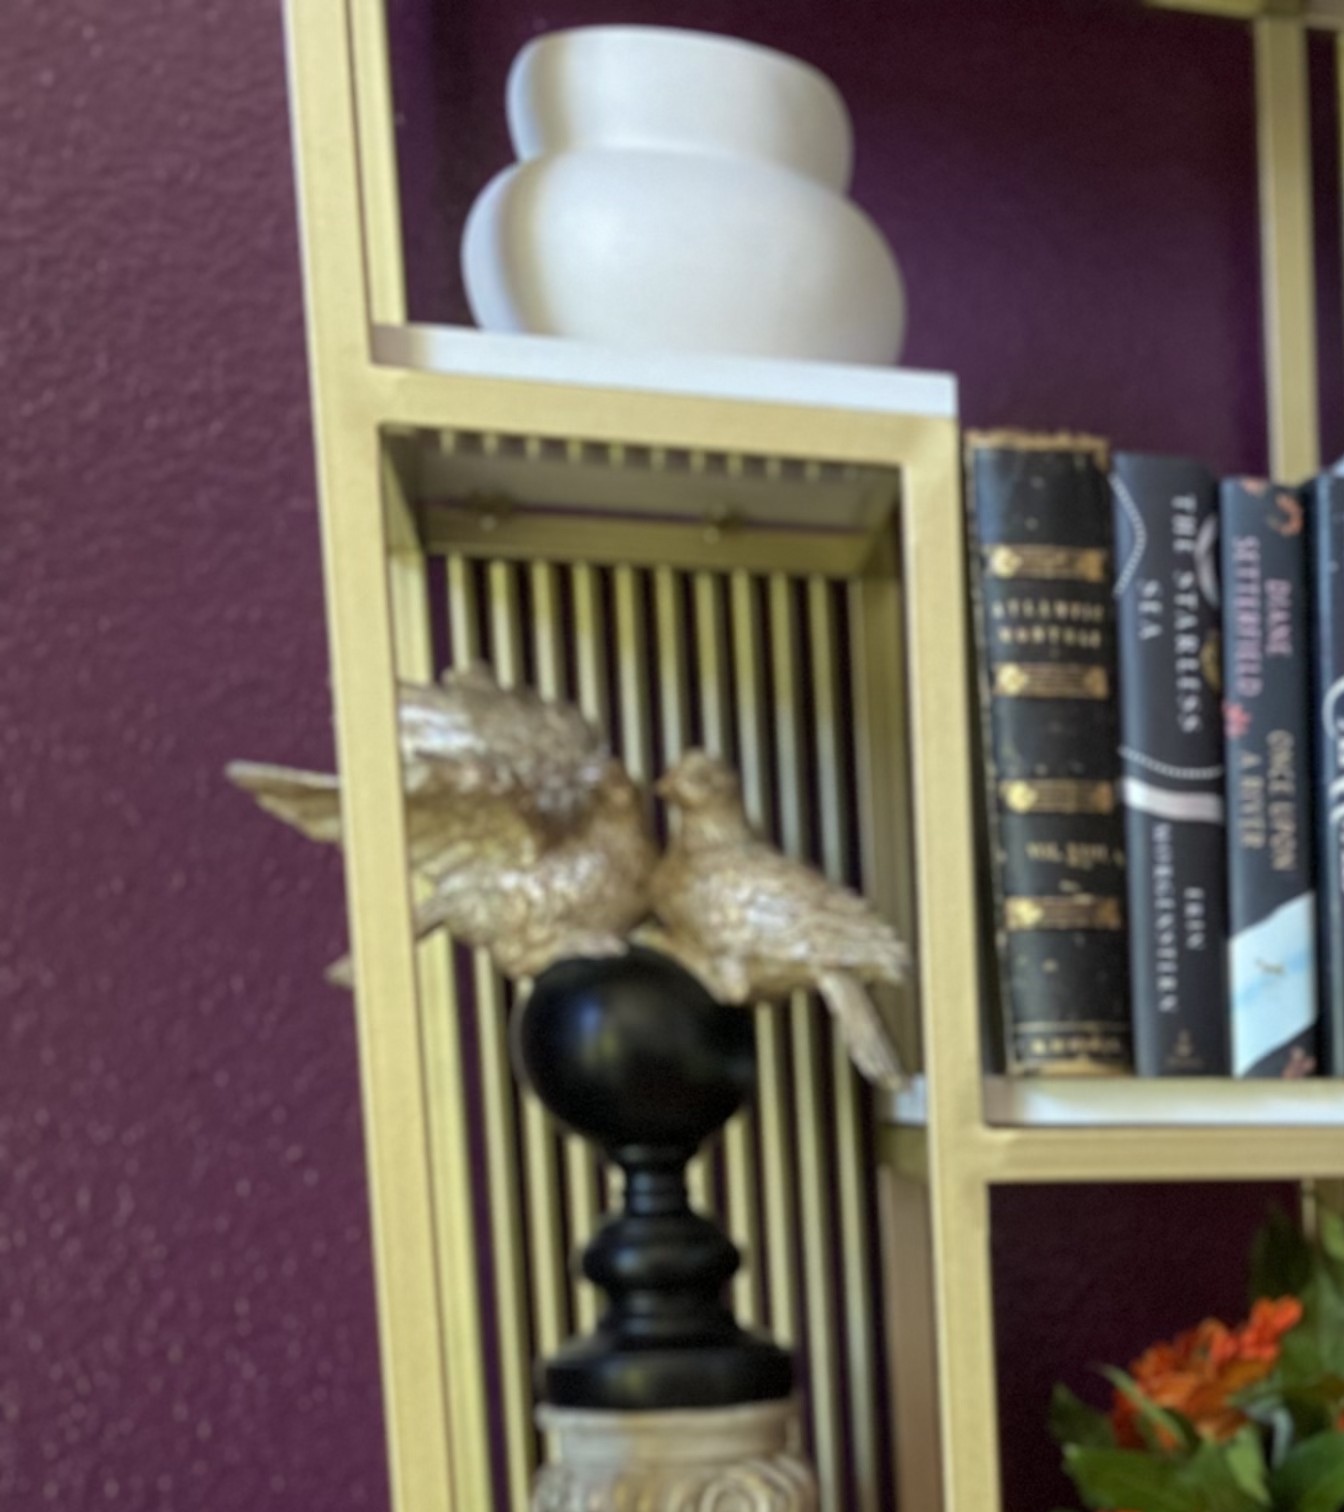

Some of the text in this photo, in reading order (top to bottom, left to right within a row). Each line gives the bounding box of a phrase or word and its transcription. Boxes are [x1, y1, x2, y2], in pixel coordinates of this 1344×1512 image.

[1137, 578, 1164, 641] SEA
[1170, 494, 1202, 734] THE STARLESS
[1264, 579, 1294, 658] DIANE
[1238, 751, 1266, 850] A RIVER
[1266, 729, 1298, 871] ONCE UPON
[1183, 886, 1206, 951] ERIN
